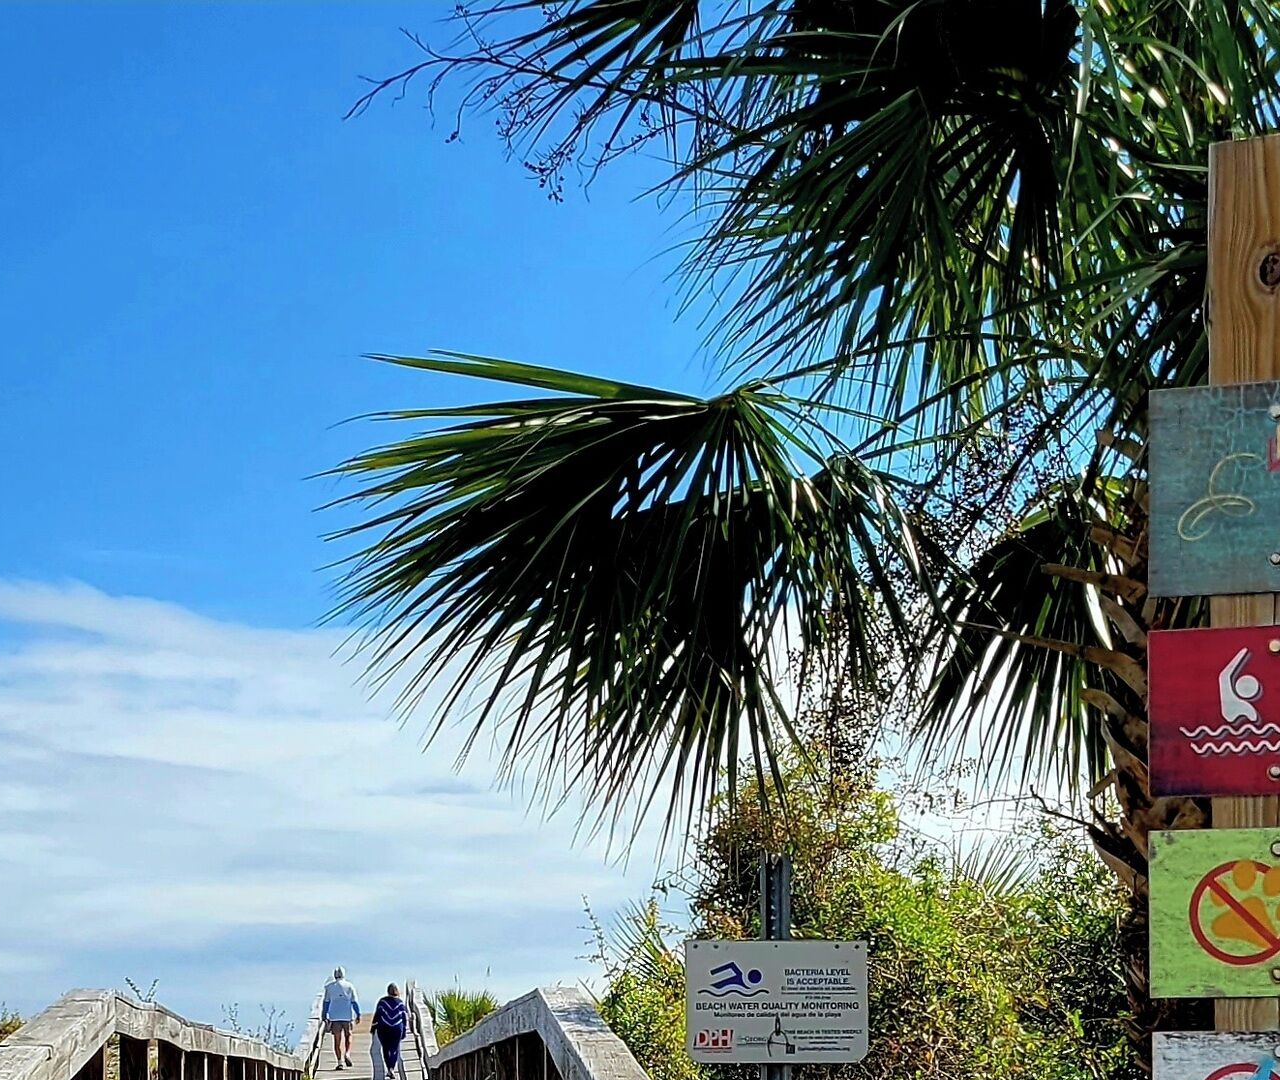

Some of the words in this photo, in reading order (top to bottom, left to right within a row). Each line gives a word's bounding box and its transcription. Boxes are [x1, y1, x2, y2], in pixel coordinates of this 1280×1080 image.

[784, 968, 824, 976] BACTERIA
[826, 968, 851, 976] LEVEL
[786, 977, 795, 985] IS
[695, 1002, 727, 1010] BEACH
[728, 1002, 760, 1010] WATER
[761, 1002, 799, 1010] QUALITY
[801, 1002, 859, 1010] MONITORING
